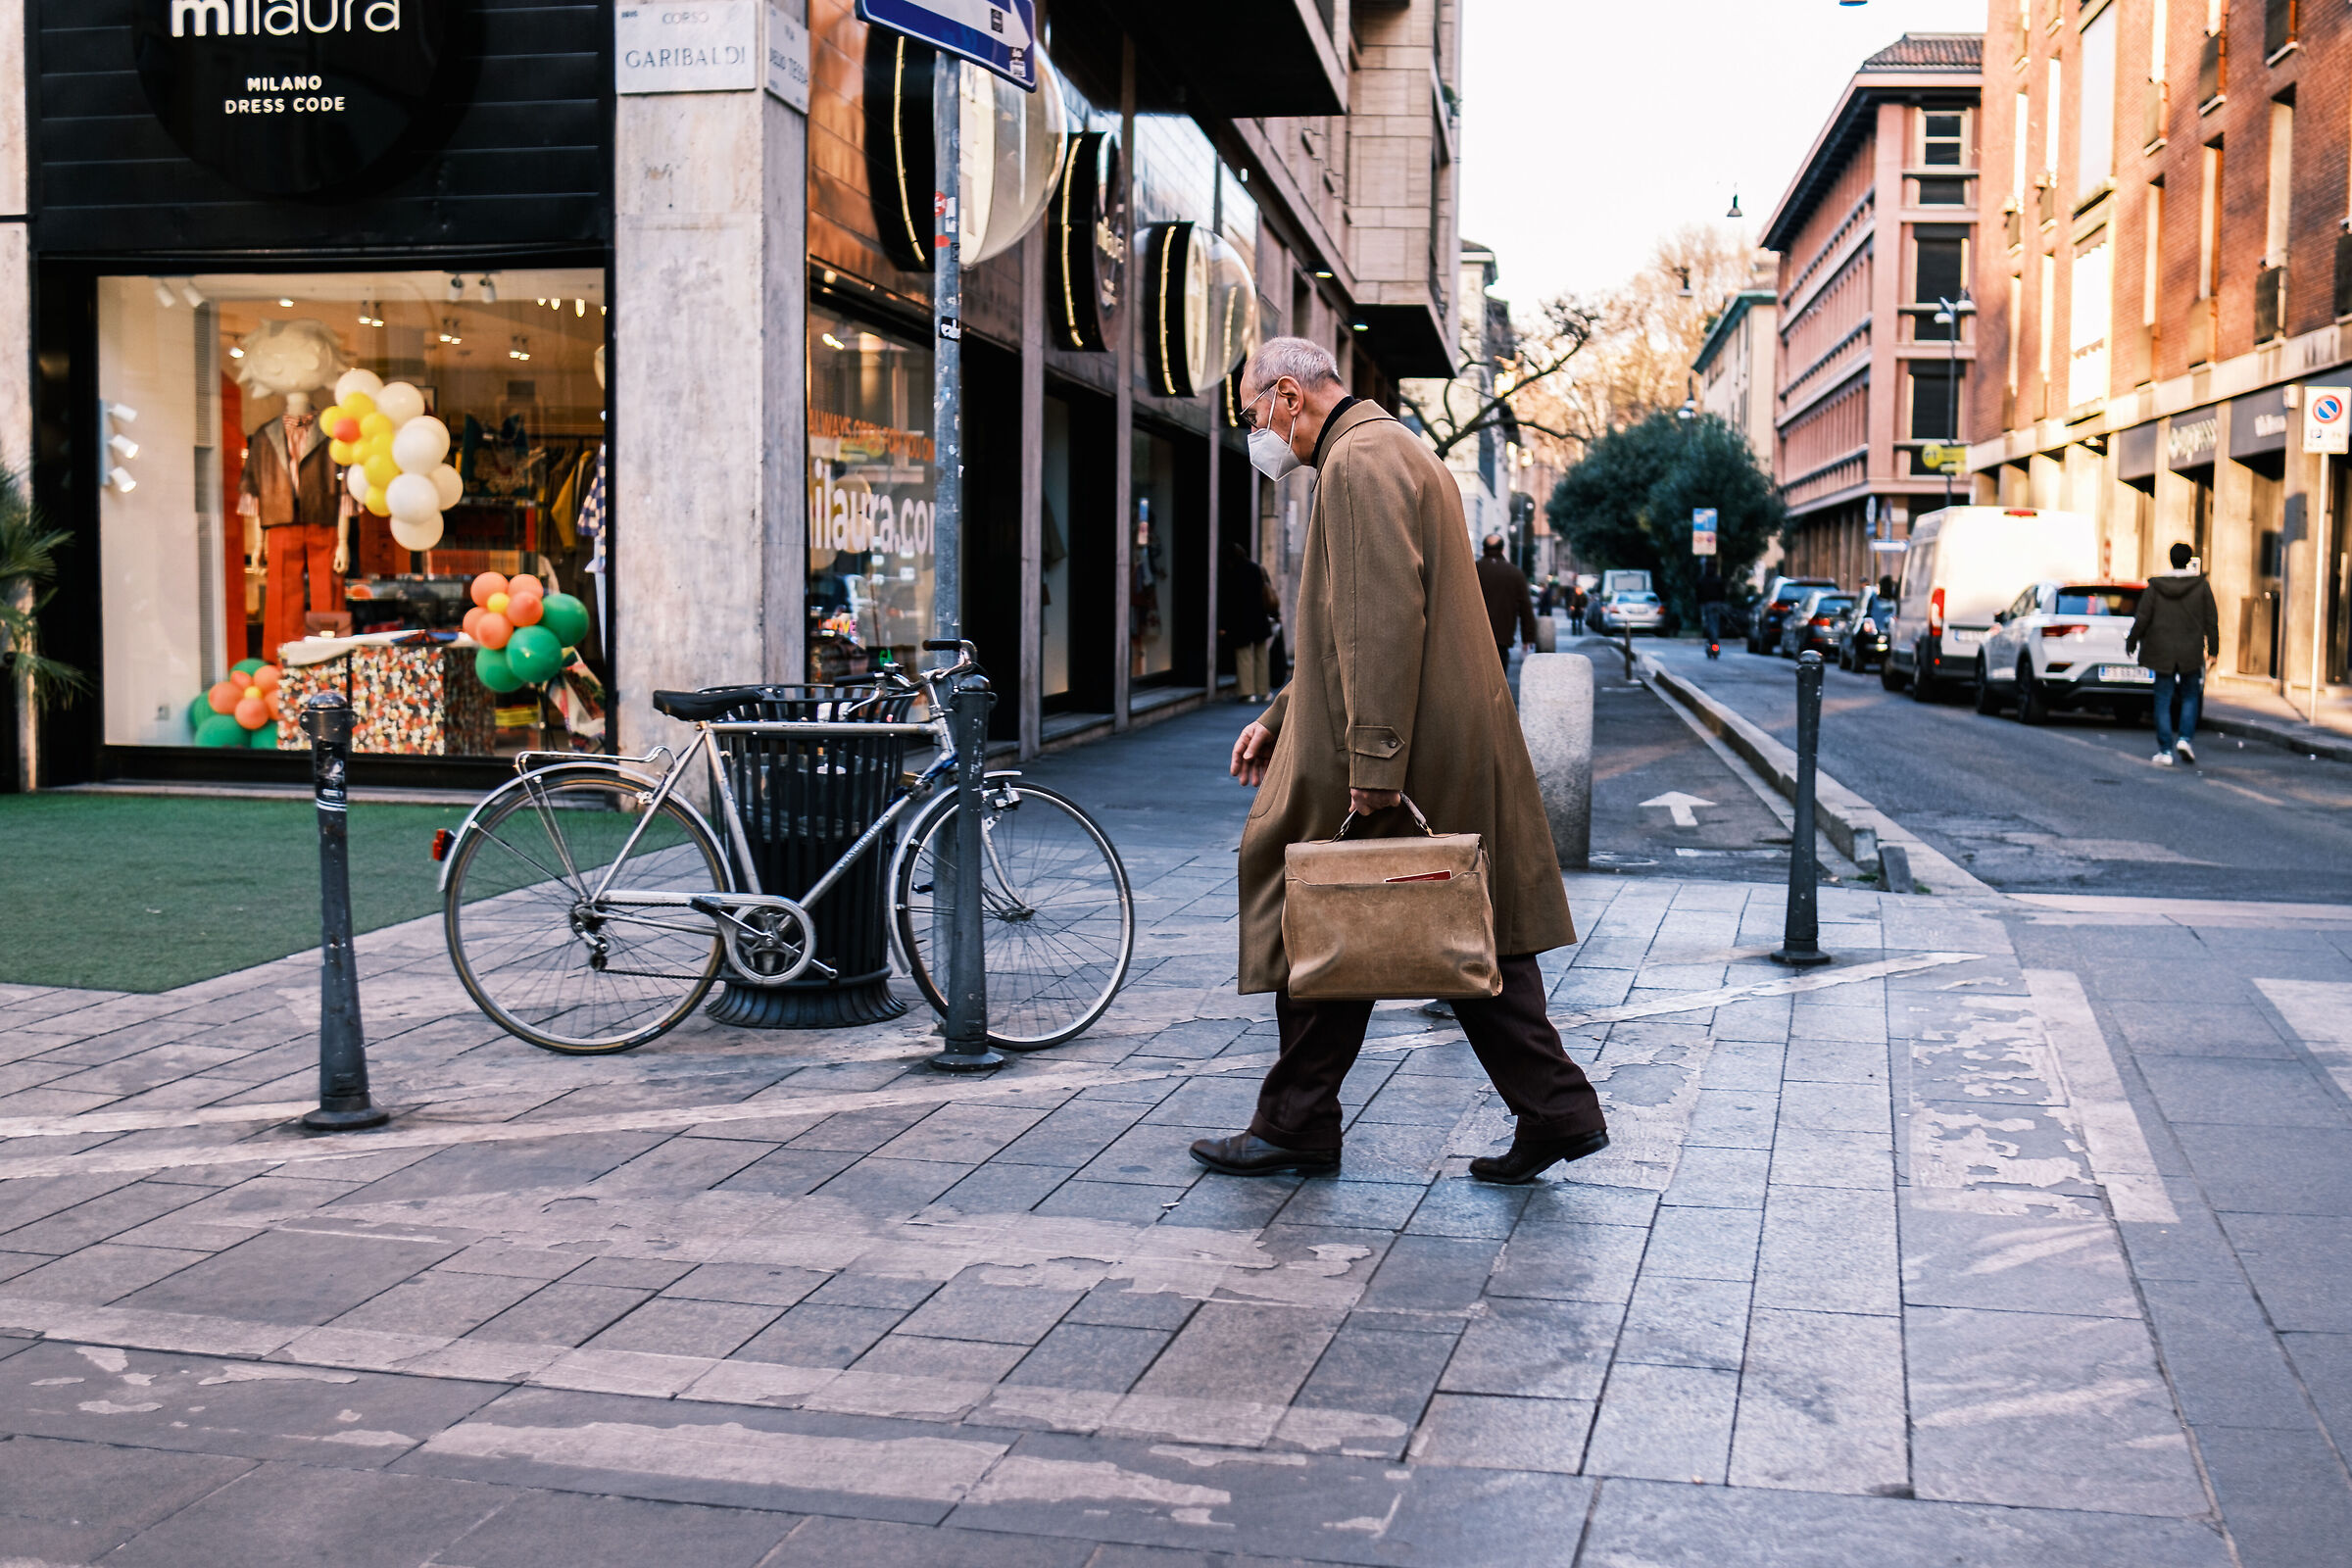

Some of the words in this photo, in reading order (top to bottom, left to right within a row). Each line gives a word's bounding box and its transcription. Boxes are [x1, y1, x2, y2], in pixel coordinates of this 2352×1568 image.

[662, 11, 710, 24] CORSO
[625, 46, 746, 69] GARIBALDI
[247, 74, 323, 92] MILANO
[224, 98, 285, 115] DRESS
[292, 96, 346, 113] CODE
[809, 457, 937, 556] ilaura.co
